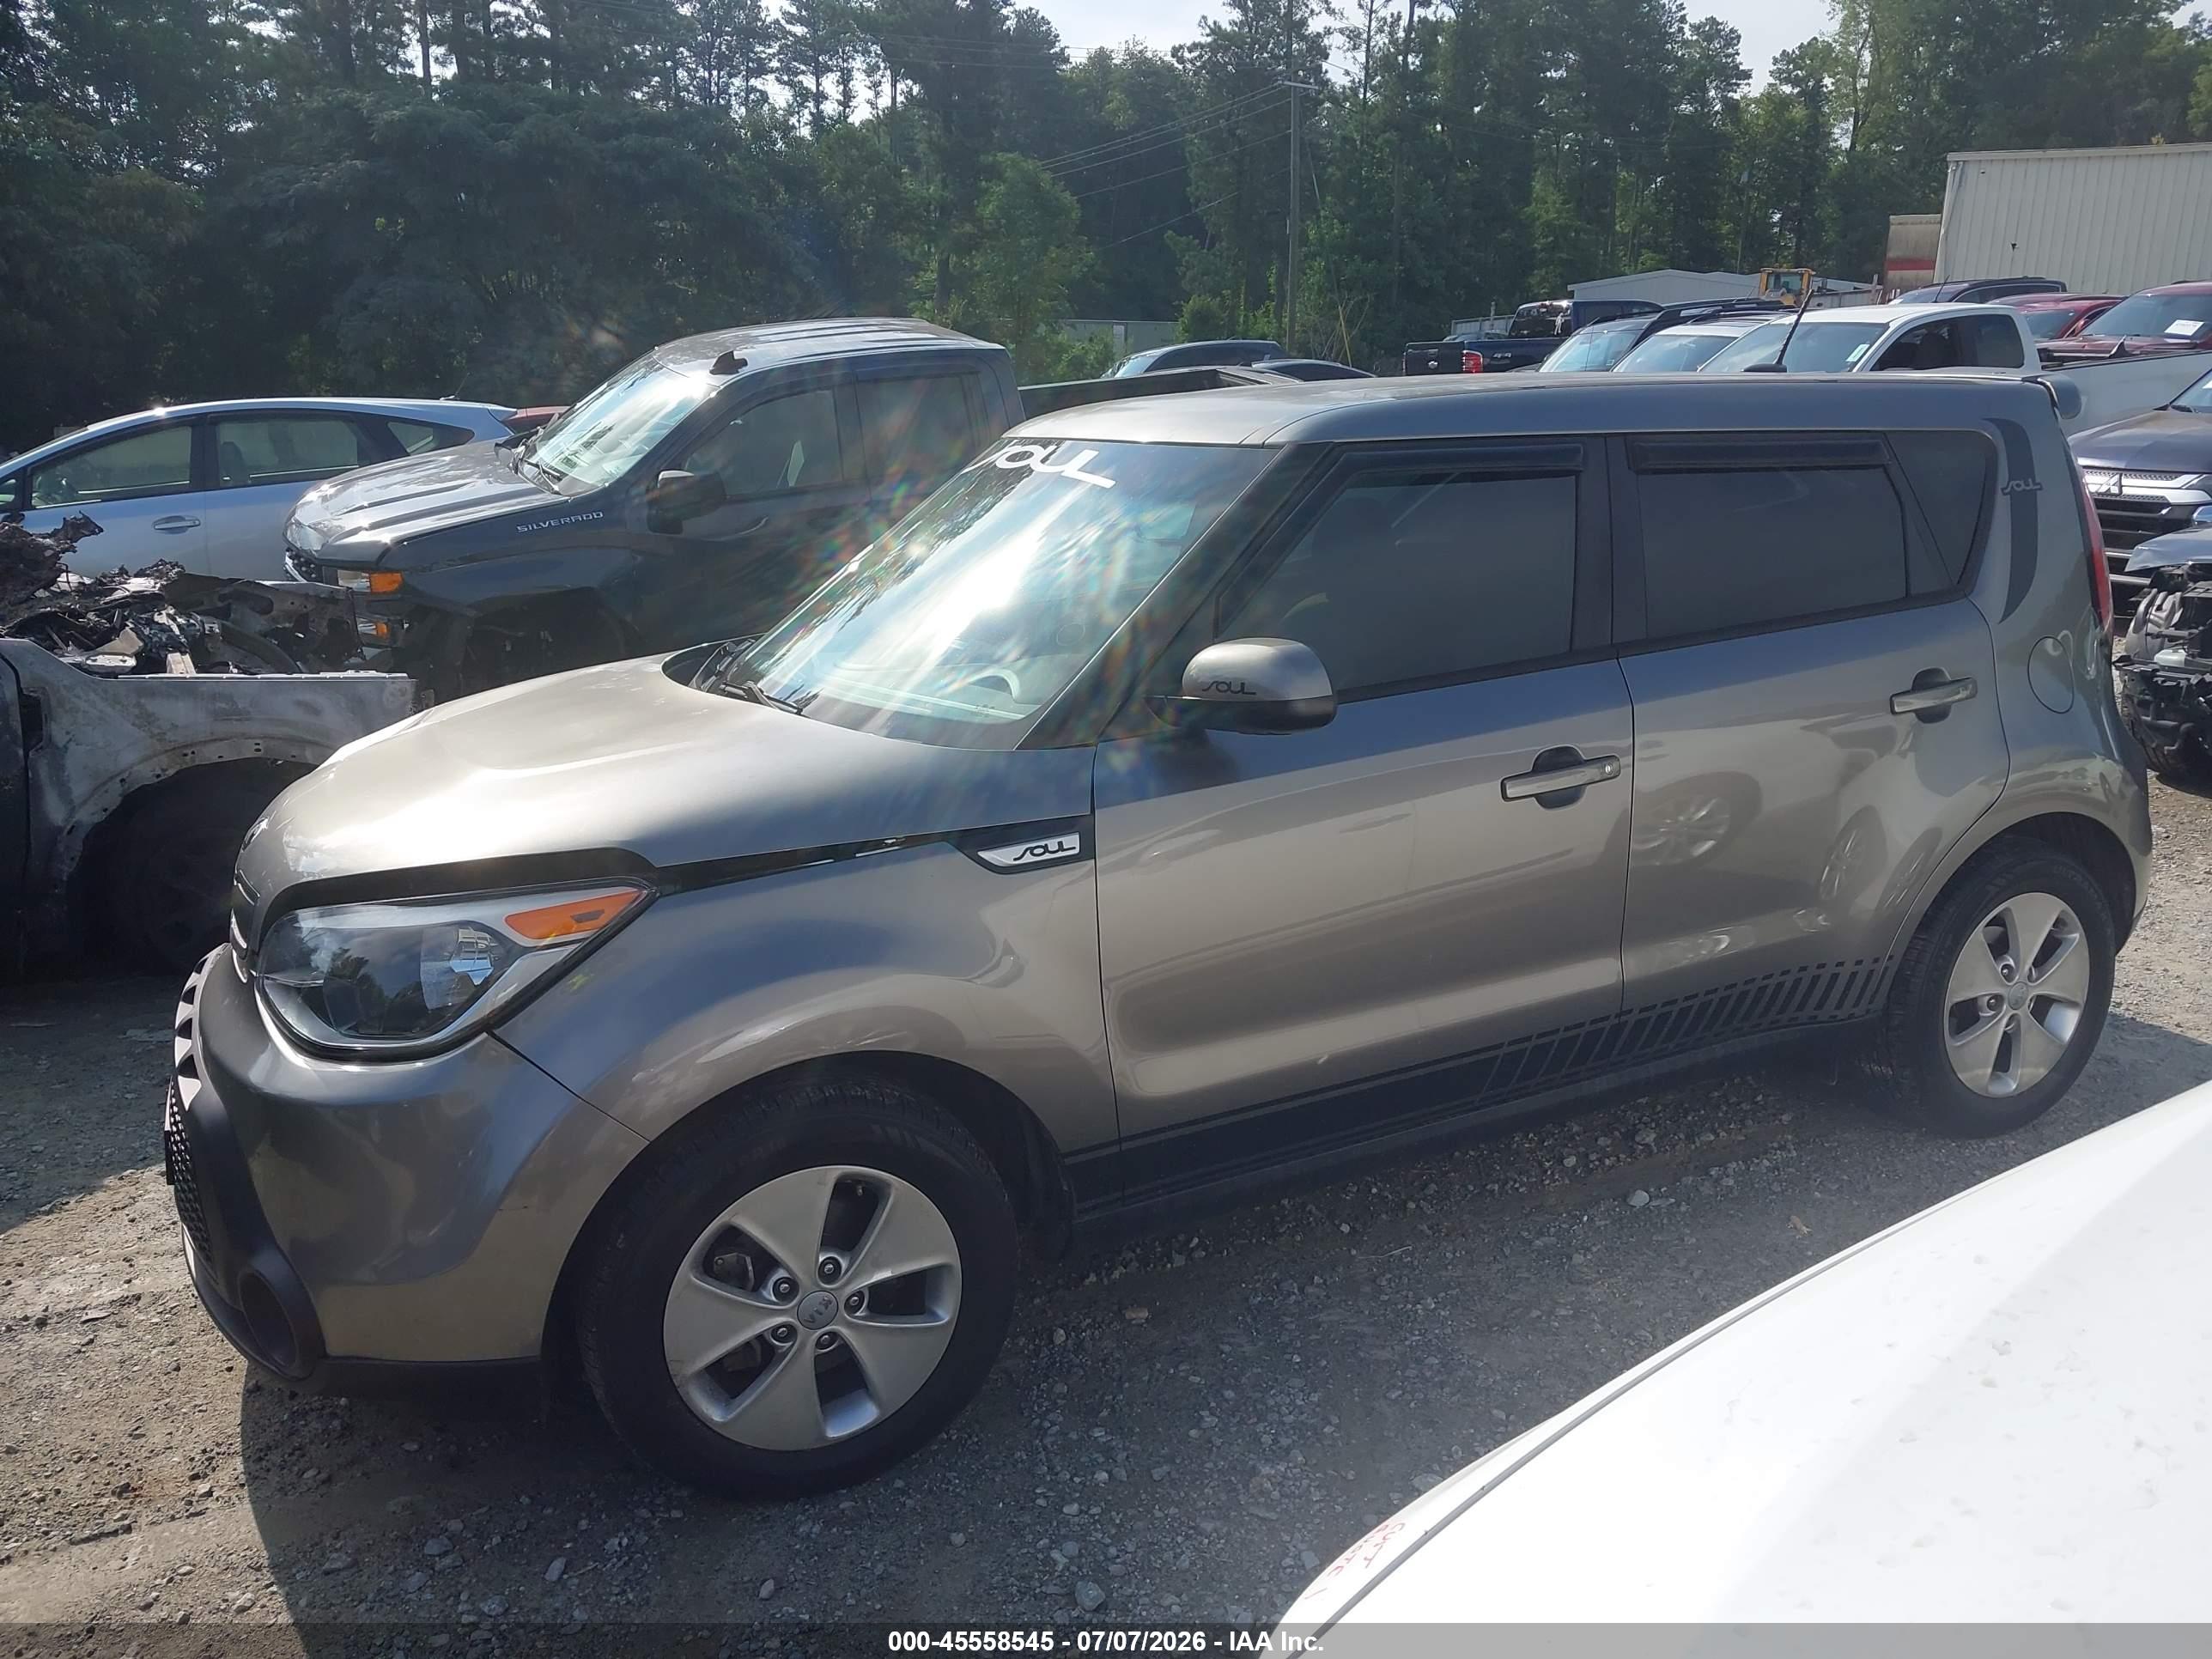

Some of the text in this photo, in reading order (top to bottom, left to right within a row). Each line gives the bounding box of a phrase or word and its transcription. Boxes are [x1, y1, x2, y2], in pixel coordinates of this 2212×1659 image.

[516, 511, 604, 532] SILVERADO
[1200, 680, 1257, 695] SOUL
[1012, 840, 1076, 860] SOUL
